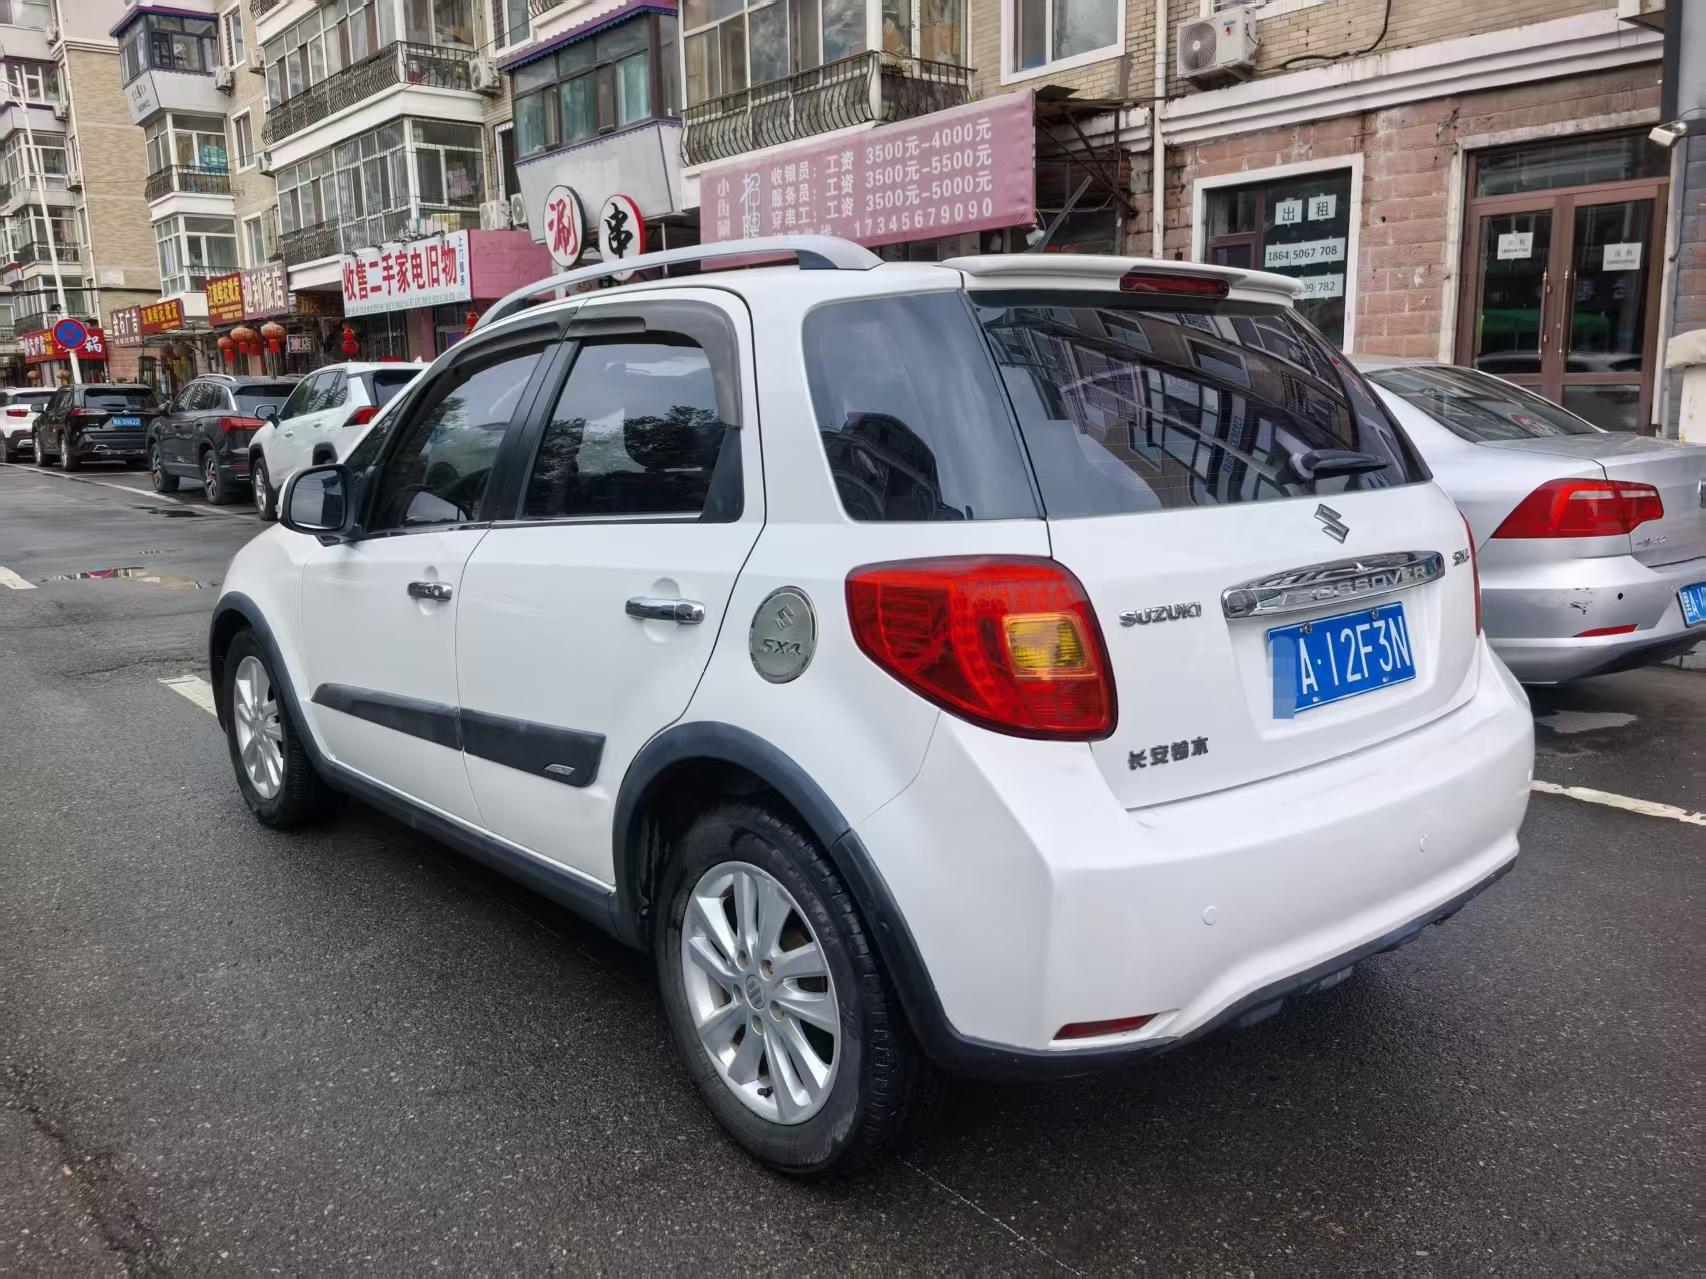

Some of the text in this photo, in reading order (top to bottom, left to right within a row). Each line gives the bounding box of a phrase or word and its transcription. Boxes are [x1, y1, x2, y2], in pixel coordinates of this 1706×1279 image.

[825, 151, 854, 174] 工资
[865, 118, 992, 164] 3500元-4000元
[826, 174, 854, 197] 工资
[865, 144, 992, 188] 3500元-5500元
[826, 197, 854, 219] 工资
[865, 170, 992, 212] 3500元-5000元
[604, 202, 633, 260] 串
[853, 198, 993, 238] 17345679090
[343, 240, 457, 301] 收售二手家电旧物
[1268, 245, 1338, 261] 1864 5067 708
[1318, 281, 1335, 292] 782
[1119, 601, 1203, 628] SUZUKI
[760, 638, 801, 656] SX4
